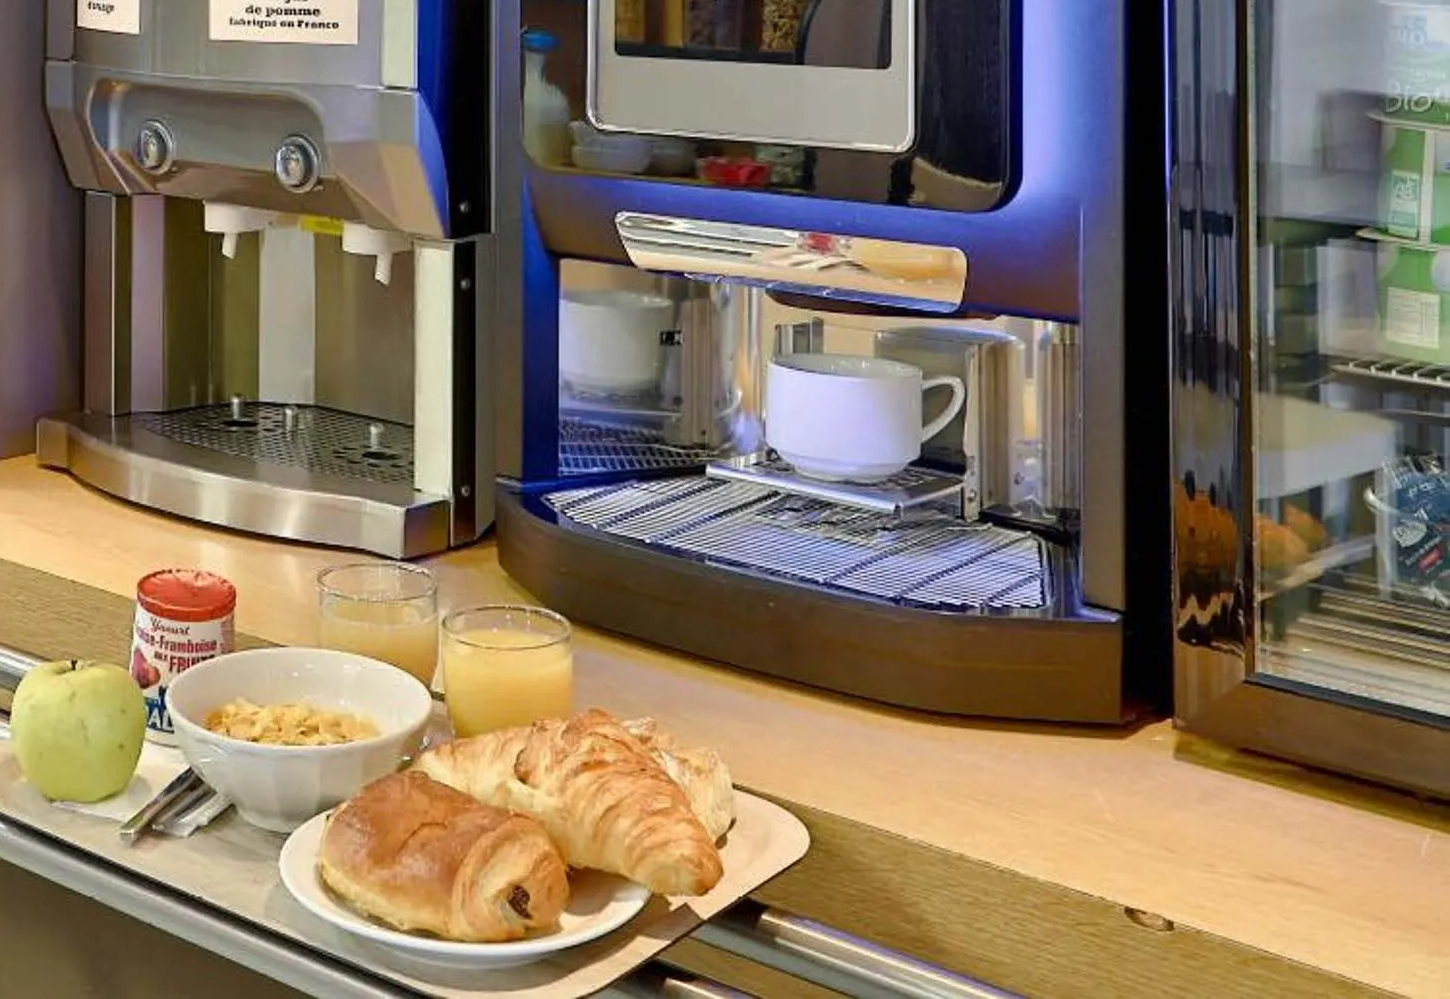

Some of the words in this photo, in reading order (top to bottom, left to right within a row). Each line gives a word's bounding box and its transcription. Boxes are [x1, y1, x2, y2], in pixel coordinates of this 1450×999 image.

[245, 4, 262, 15] de
[265, 6, 321, 18] pomme
[297, 19, 340, 30] France
